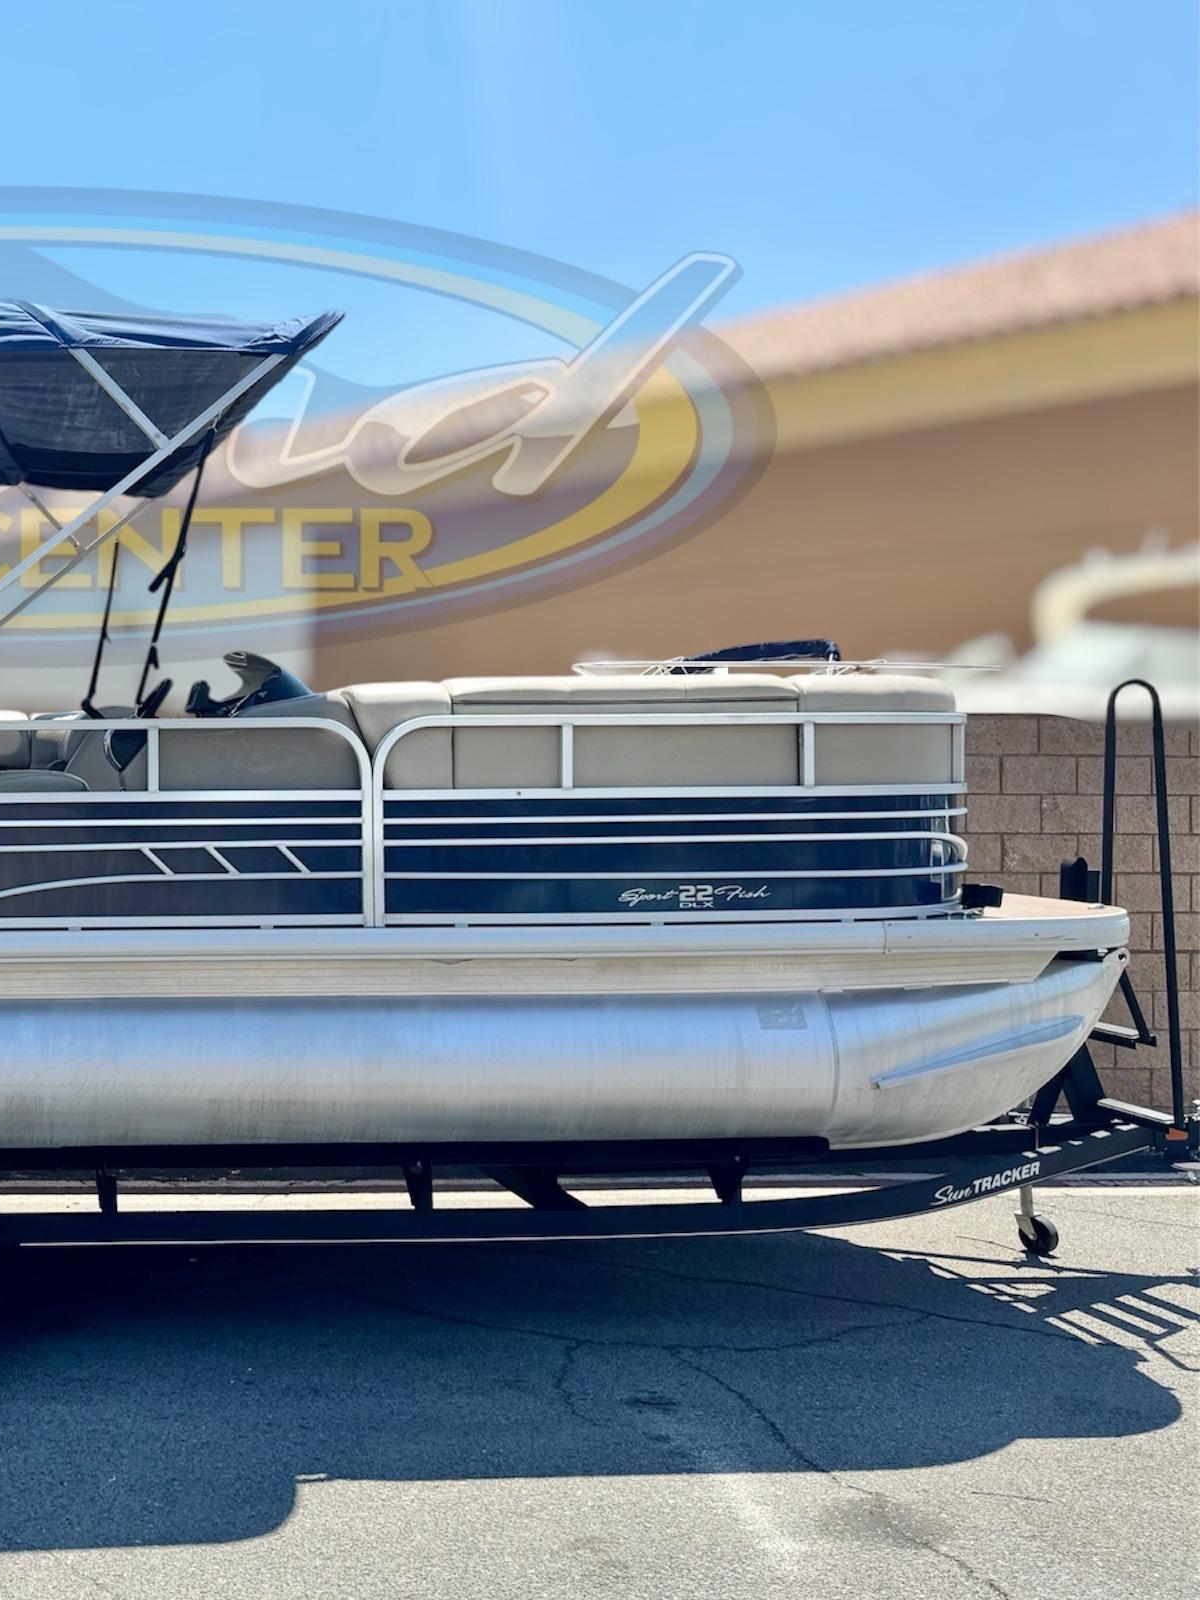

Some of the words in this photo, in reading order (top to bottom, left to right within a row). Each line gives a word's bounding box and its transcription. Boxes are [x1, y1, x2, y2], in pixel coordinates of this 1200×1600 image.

[617, 887, 678, 908] Sport
[678, 884, 715, 902] 22
[713, 884, 772, 902] Fish
[929, 1184, 973, 1206] Sun
[972, 1160, 1041, 1194] TRACKER
